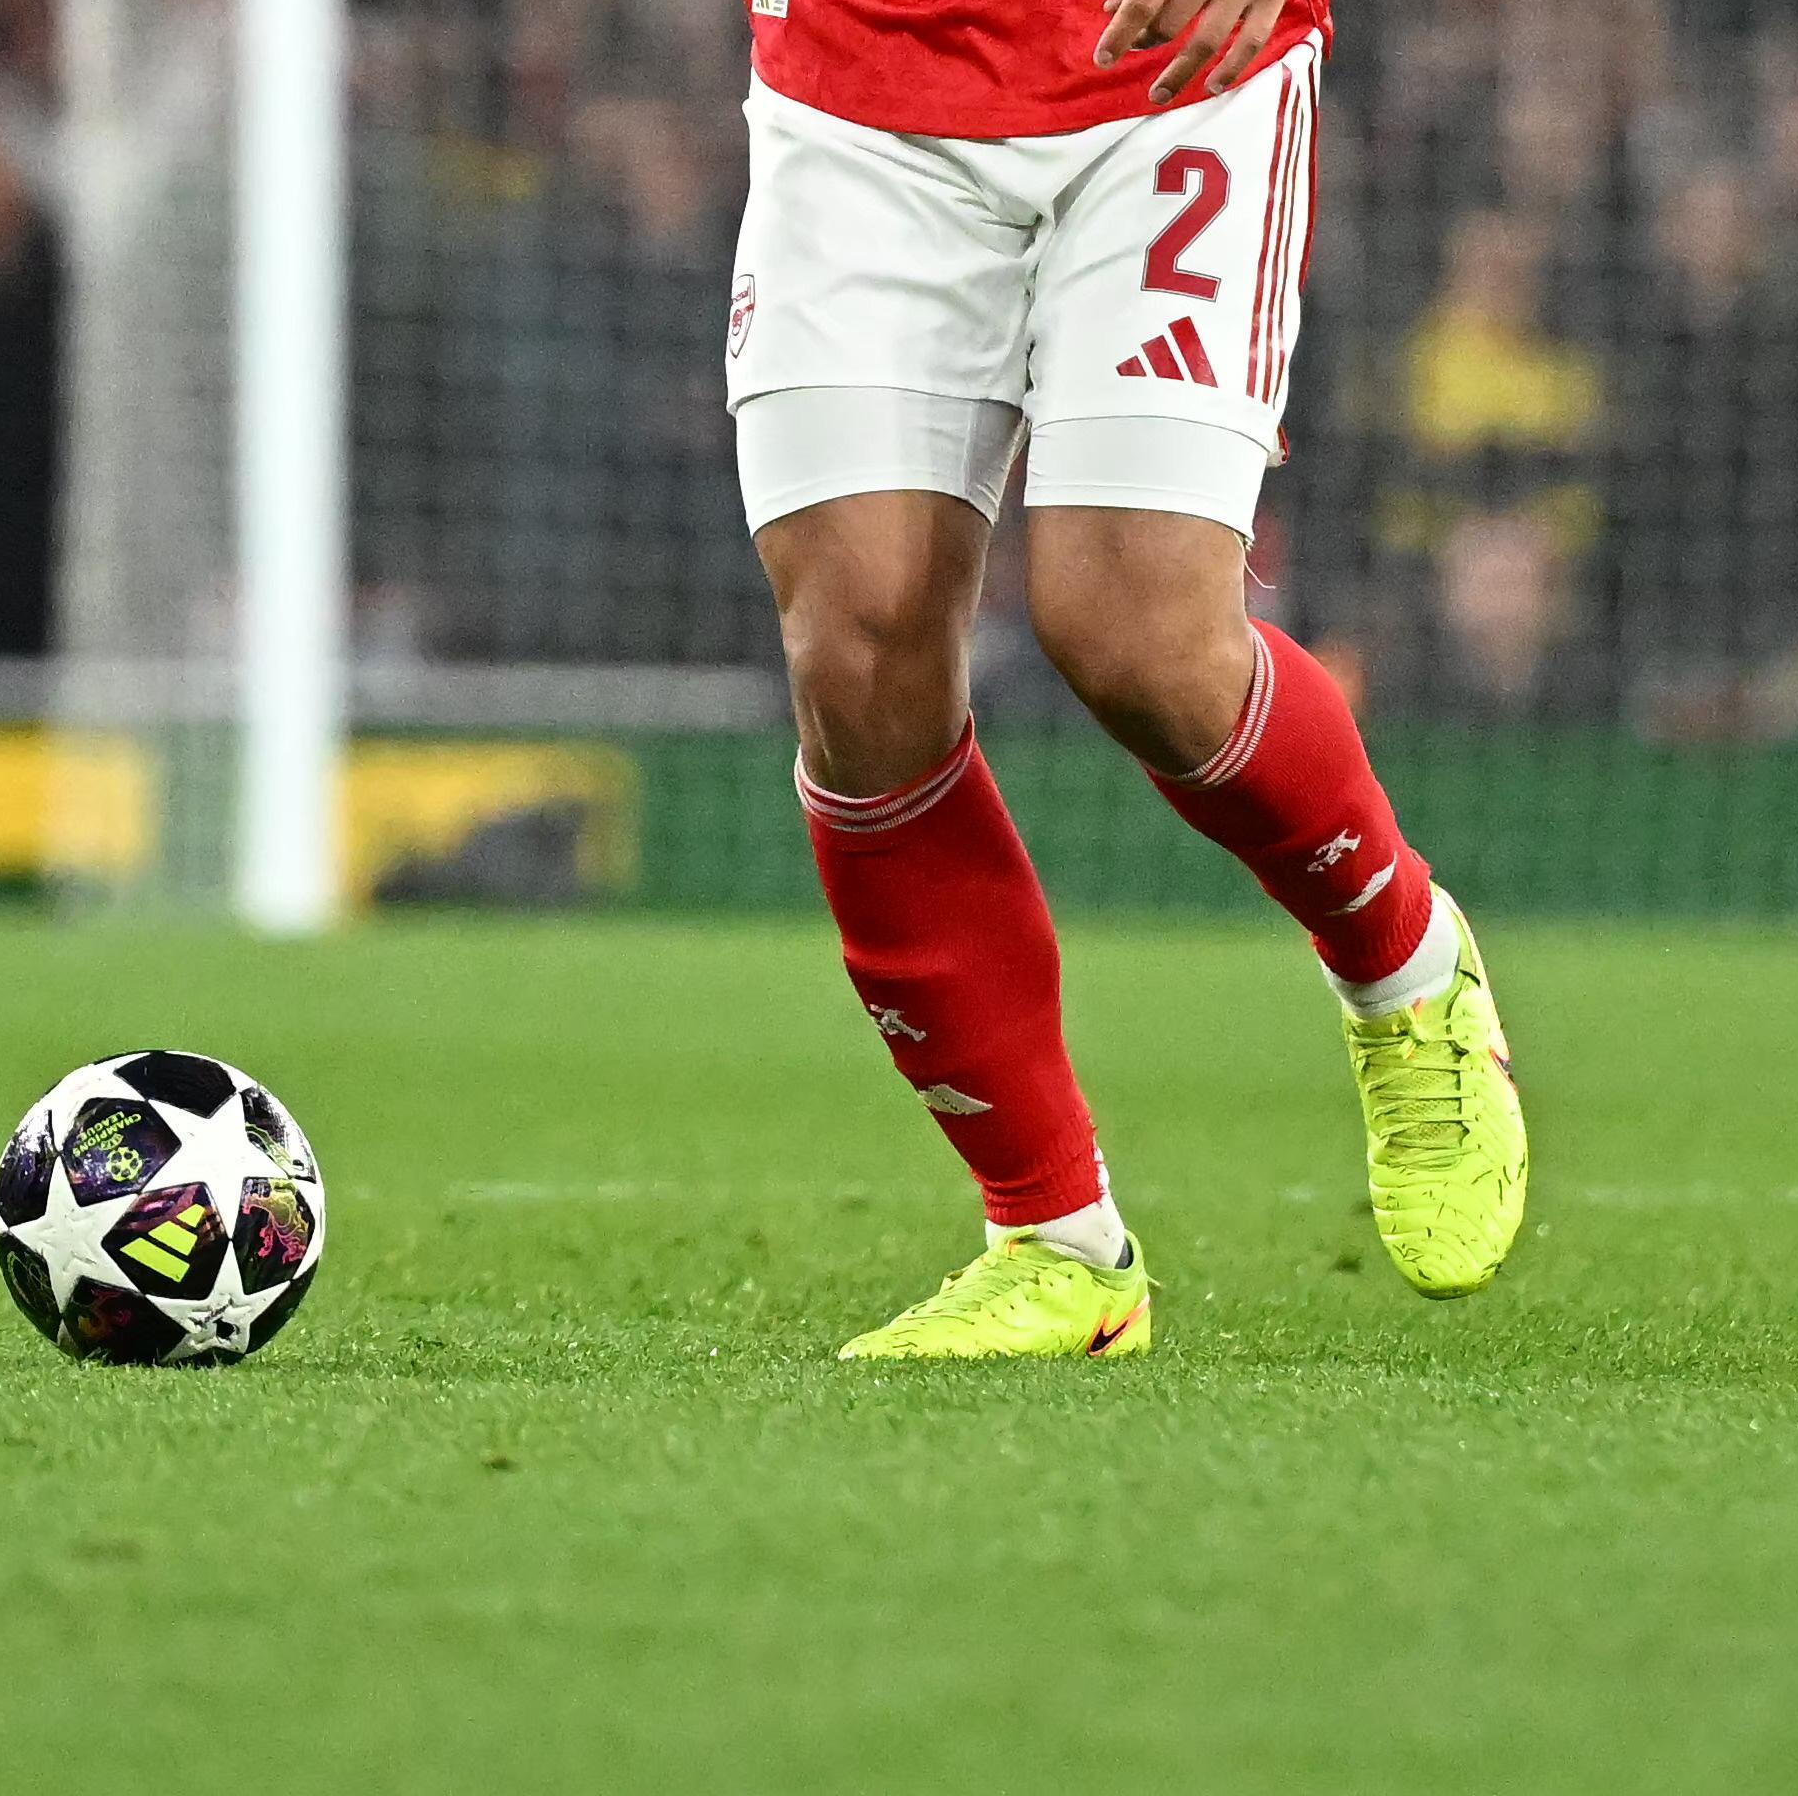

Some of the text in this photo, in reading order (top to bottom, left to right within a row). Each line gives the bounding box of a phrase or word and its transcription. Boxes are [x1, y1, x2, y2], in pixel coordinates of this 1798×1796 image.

[1140, 145, 1231, 302] 2
[73, 1113, 141, 1157] CHAMPIONS
[76, 1111, 125, 1142] LEAGUE
